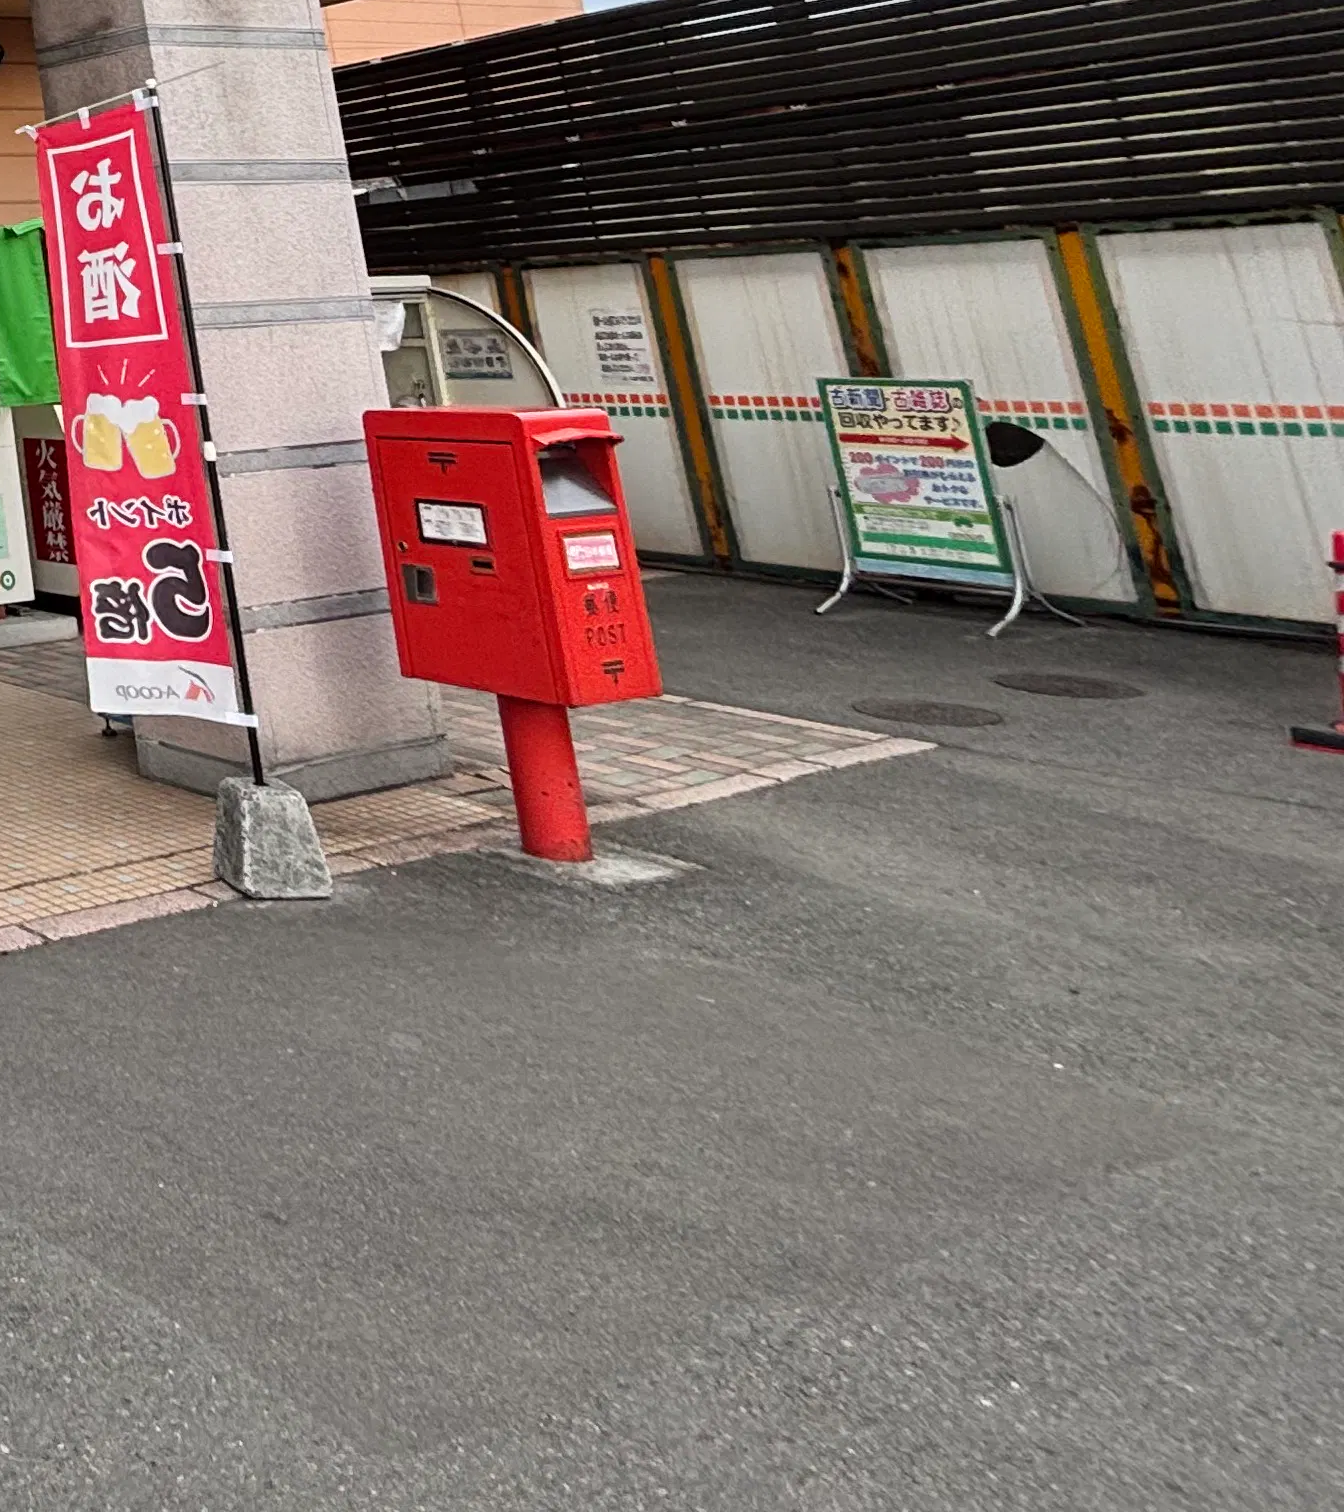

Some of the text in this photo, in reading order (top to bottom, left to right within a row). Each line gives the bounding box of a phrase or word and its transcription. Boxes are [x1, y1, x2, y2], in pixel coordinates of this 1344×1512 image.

[34, 439, 70, 563] 火気厳禁
[584, 623, 626, 648] POST
